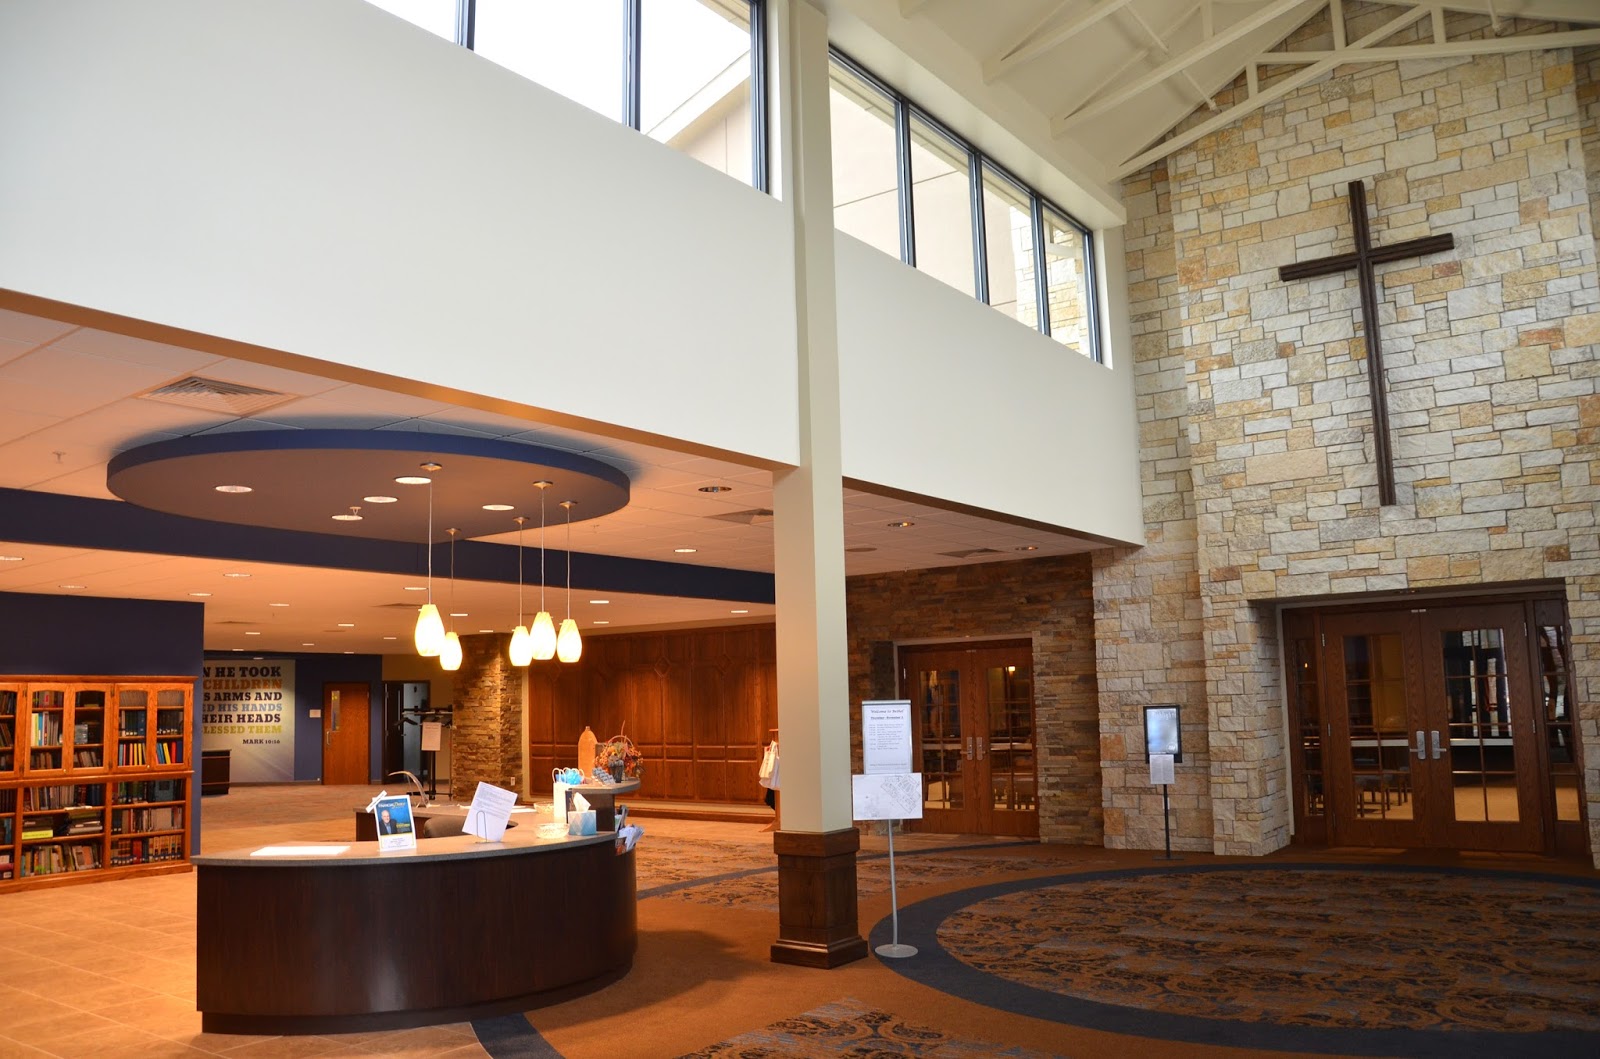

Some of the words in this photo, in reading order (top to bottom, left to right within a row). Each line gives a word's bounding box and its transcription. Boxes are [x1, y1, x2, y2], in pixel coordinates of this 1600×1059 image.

[215, 667, 235, 677] HE
[239, 667, 281, 677] TOOK
[203, 679, 282, 689] CHILDREN
[214, 692, 251, 701] ARMS
[254, 692, 282, 701] AND
[218, 704, 238, 712] HIS
[242, 704, 282, 712] HANDS
[236, 714, 281, 723] HEADS
[248, 725, 282, 734] THEM
